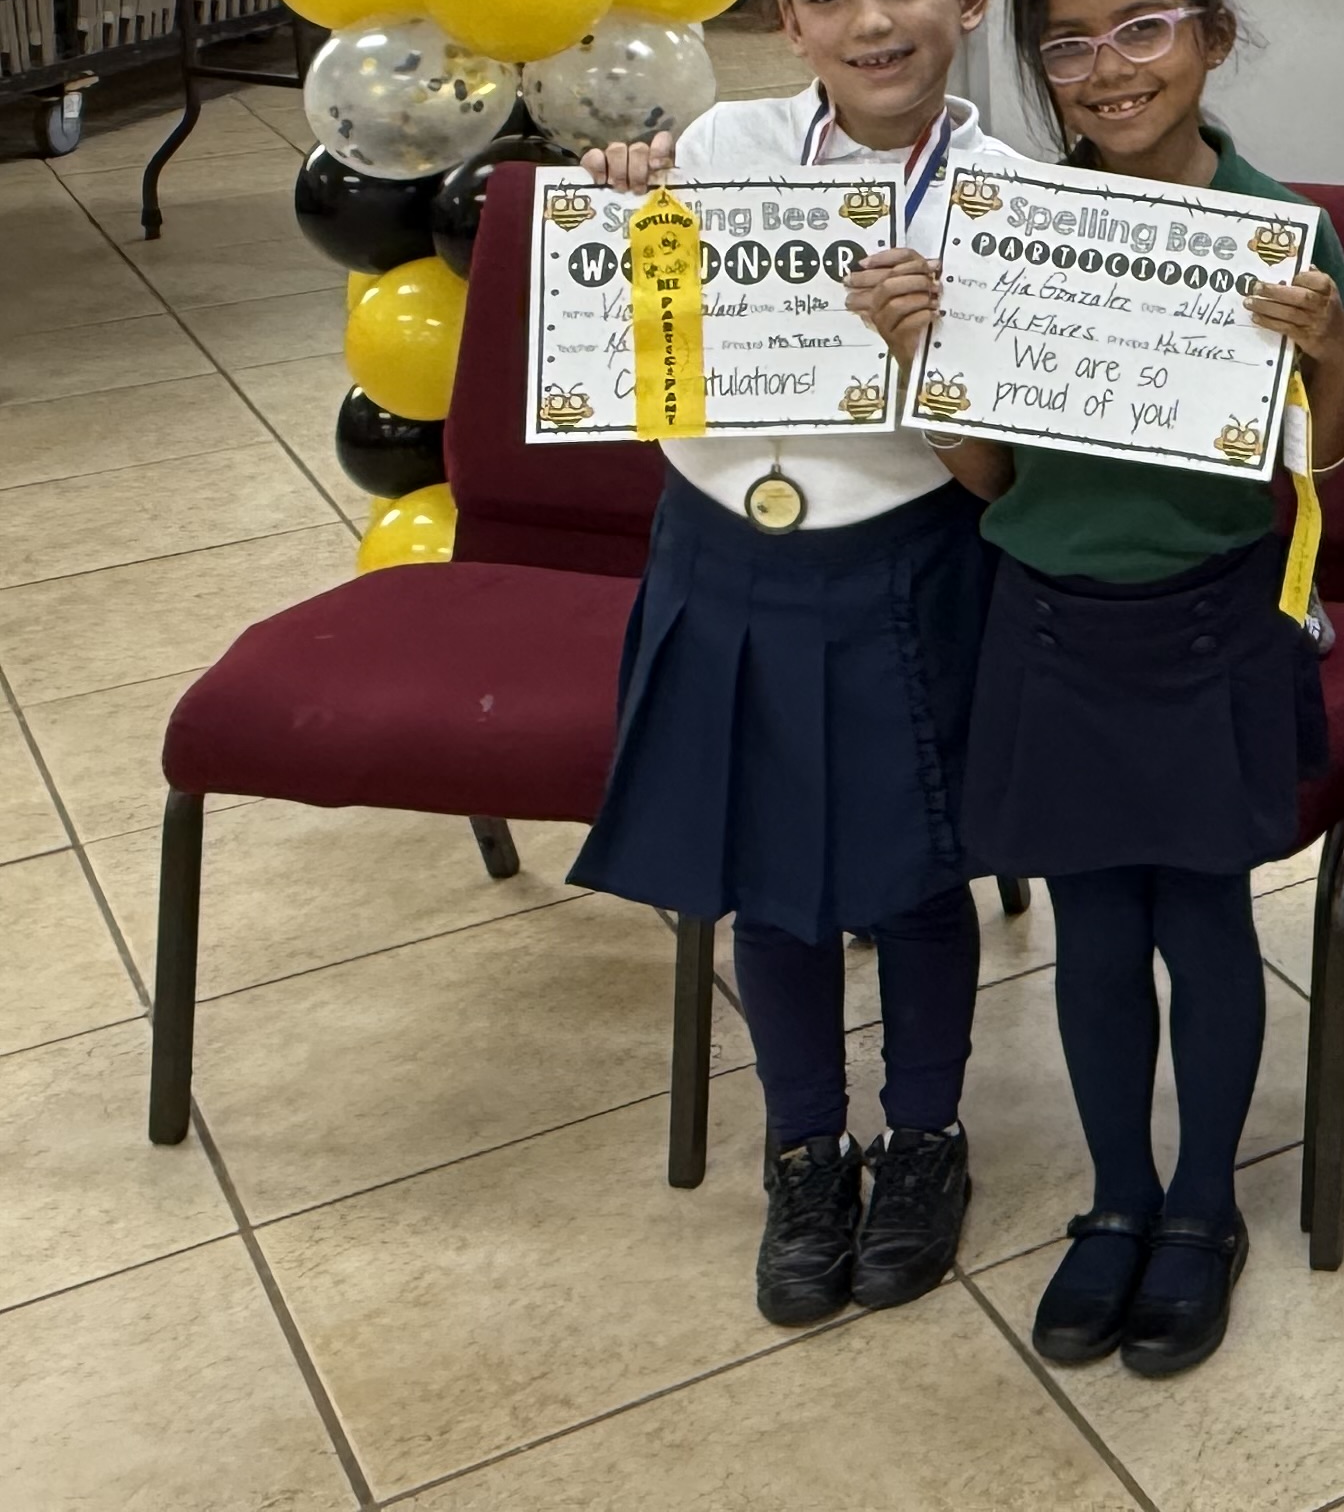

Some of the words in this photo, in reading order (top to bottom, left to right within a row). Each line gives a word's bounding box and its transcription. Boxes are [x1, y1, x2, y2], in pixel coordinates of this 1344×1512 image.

[602, 200, 753, 239] Sing
[761, 201, 830, 232] Bee
[1006, 195, 1158, 253] Spelling
[1166, 221, 1239, 261] Bee
[577, 240, 855, 285] WNER
[974, 234, 1258, 295] PARTICIPANT
[614, 367, 816, 400] Ctulations!
[1013, 336, 1059, 374] We
[1076, 356, 1121, 383] are
[1139, 367, 1169, 389] so
[991, 380, 1069, 413] proud
[1084, 390, 1114, 419] of
[1131, 399, 1181, 437] you!
